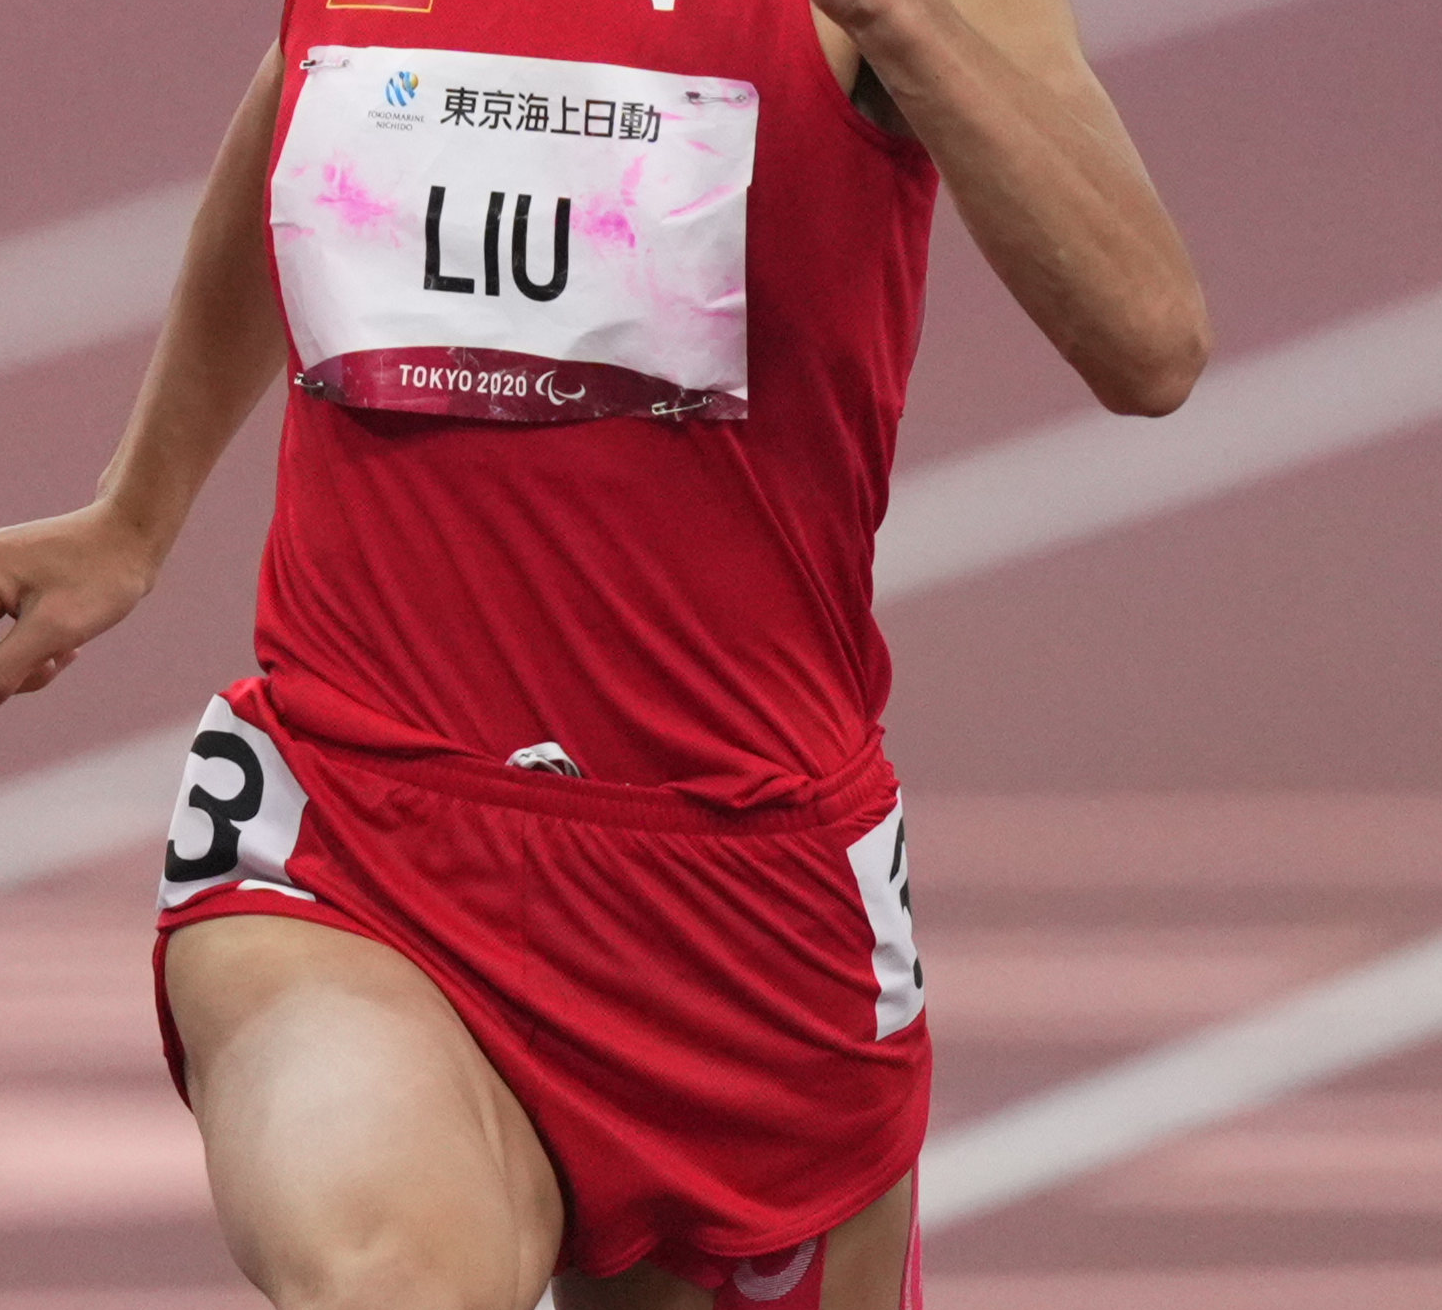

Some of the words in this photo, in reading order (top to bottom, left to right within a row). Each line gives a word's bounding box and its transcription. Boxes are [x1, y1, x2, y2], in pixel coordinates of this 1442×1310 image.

[439, 86, 663, 143] 東京海上日動
[422, 184, 572, 303] LIU
[398, 364, 472, 393] TOKYO
[476, 371, 528, 398] 2020
[164, 730, 265, 883] 3
